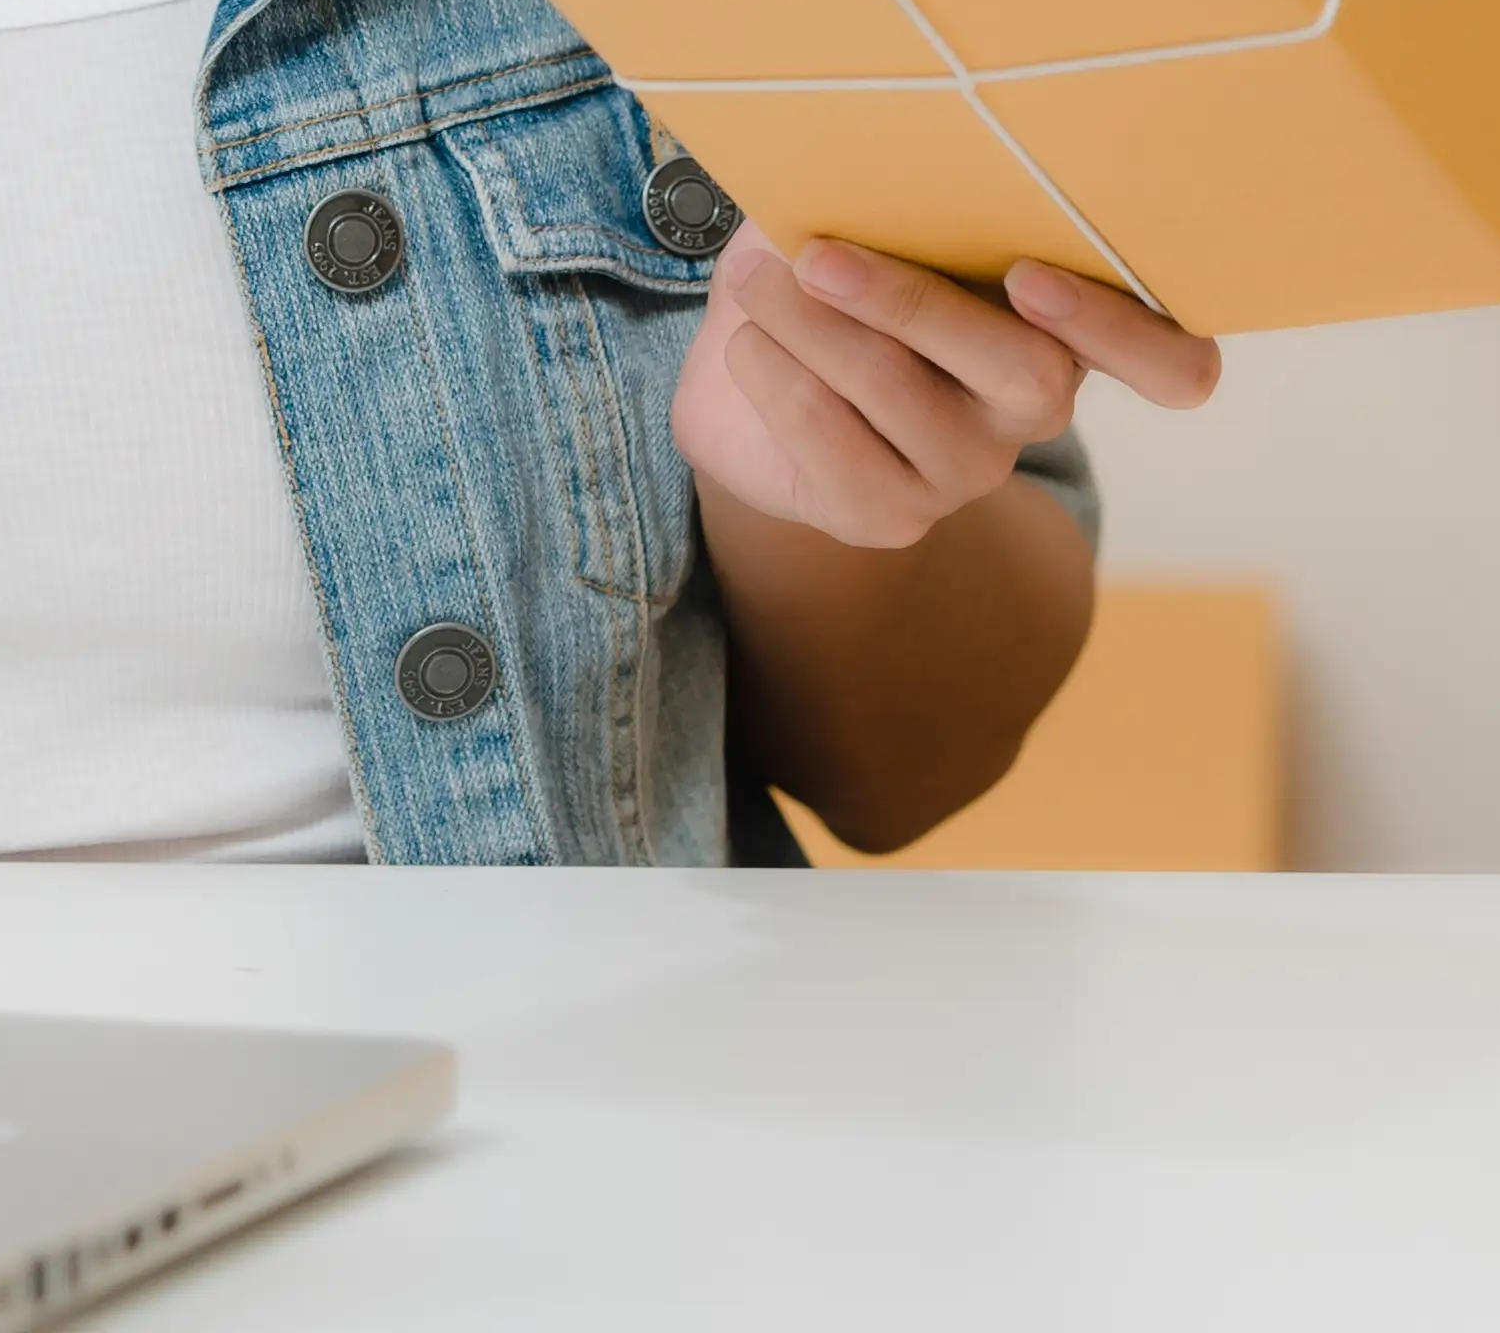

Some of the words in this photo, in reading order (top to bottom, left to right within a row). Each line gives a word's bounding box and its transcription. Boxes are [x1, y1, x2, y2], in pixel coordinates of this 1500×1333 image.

[648, 188, 668, 226] 1995
[362, 201, 397, 251] JEANS
[670, 226, 705, 247] EST.
[310, 242, 338, 278] 1995
[344, 264, 381, 285] EST.
[461, 638, 489, 687] JEANS
[402, 669, 425, 705] 1995
[430, 698, 466, 715] EST.
